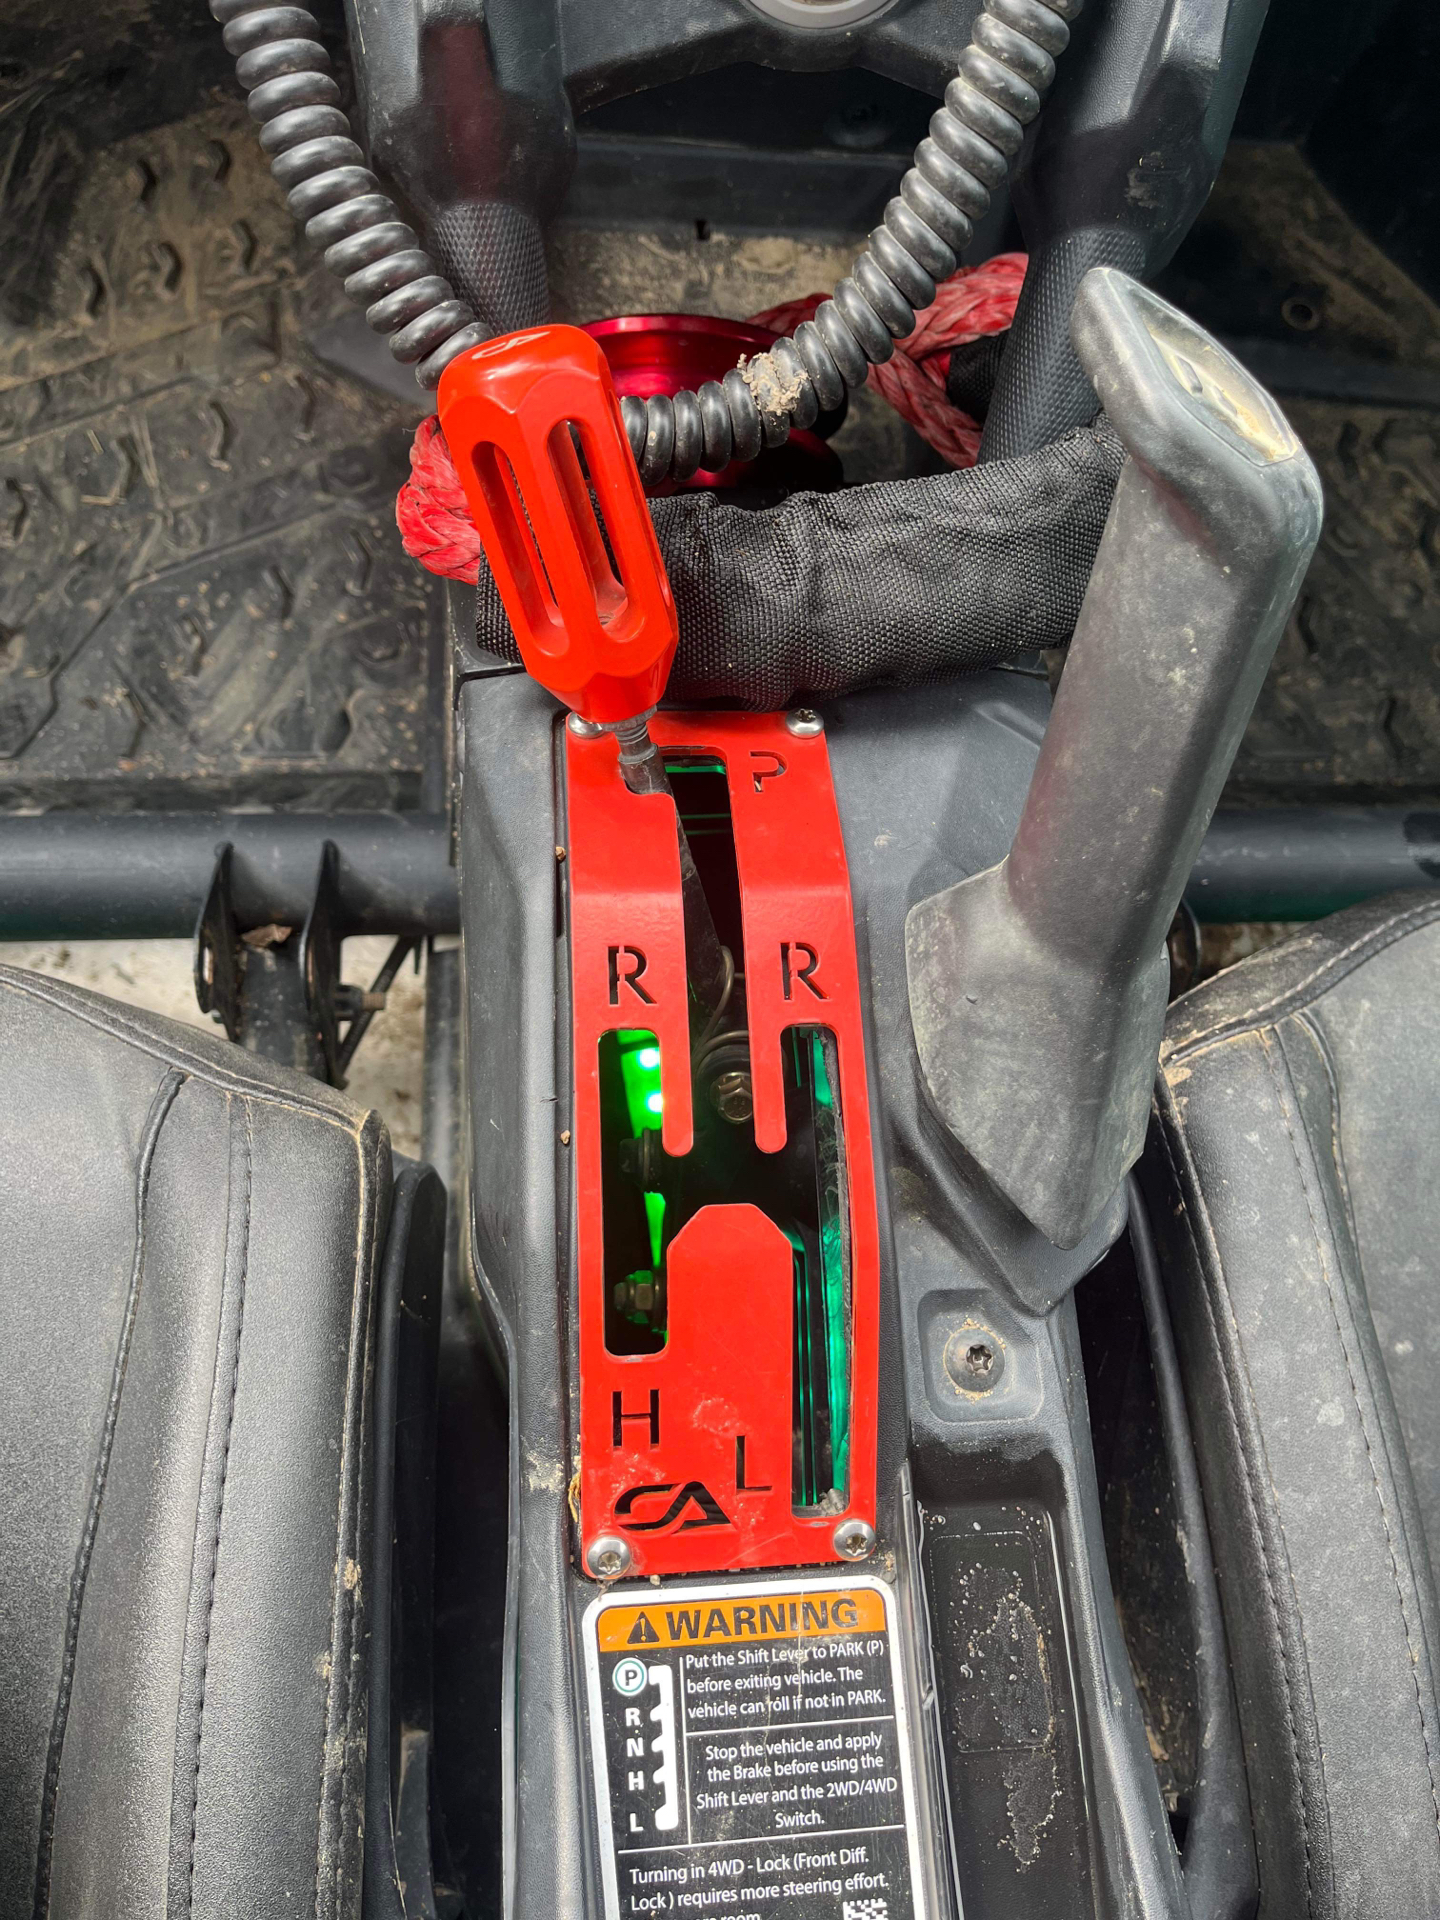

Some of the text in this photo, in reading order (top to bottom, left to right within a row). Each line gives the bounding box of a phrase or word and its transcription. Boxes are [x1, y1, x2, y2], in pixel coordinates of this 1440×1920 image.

[750, 751, 788, 793] P
[607, 945, 658, 1005] R
[780, 942, 831, 1002] R
[612, 1388, 660, 1449] H
[735, 1434, 773, 1493] L
[666, 1598, 859, 1641] WARNING
[686, 1640, 884, 1669] Put the Shift Lever to PARK (P)
[624, 1668, 638, 1686] P
[687, 1667, 864, 1694] before exiting vehicle. The
[625, 1708, 641, 1727] R
[688, 1689, 887, 1718] vehicle can roll if not in PARK.
[626, 1738, 644, 1757] N
[705, 1731, 883, 1762] Stop the vehicle and apply
[628, 1771, 644, 1791] H
[707, 1752, 884, 1783] the Brake before using the
[696, 1776, 898, 1809] Shift Lever and the 2WD/4WD
[629, 1813, 644, 1832] L
[775, 1809, 825, 1828] Switch.
[629, 1865, 687, 1886] Turning
[691, 1862, 705, 1879] in
[708, 1859, 745, 1877] 4WD
[756, 1853, 791, 1873] Lock
[793, 1850, 837, 1871] (Front
[840, 1846, 870, 1865] Diff.
[631, 1890, 665, 1911] Lock
[677, 1886, 738, 1909] requires
[740, 1885, 780, 1901] more
[782, 1875, 842, 1897] steering
[845, 1871, 889, 1891] effort.
